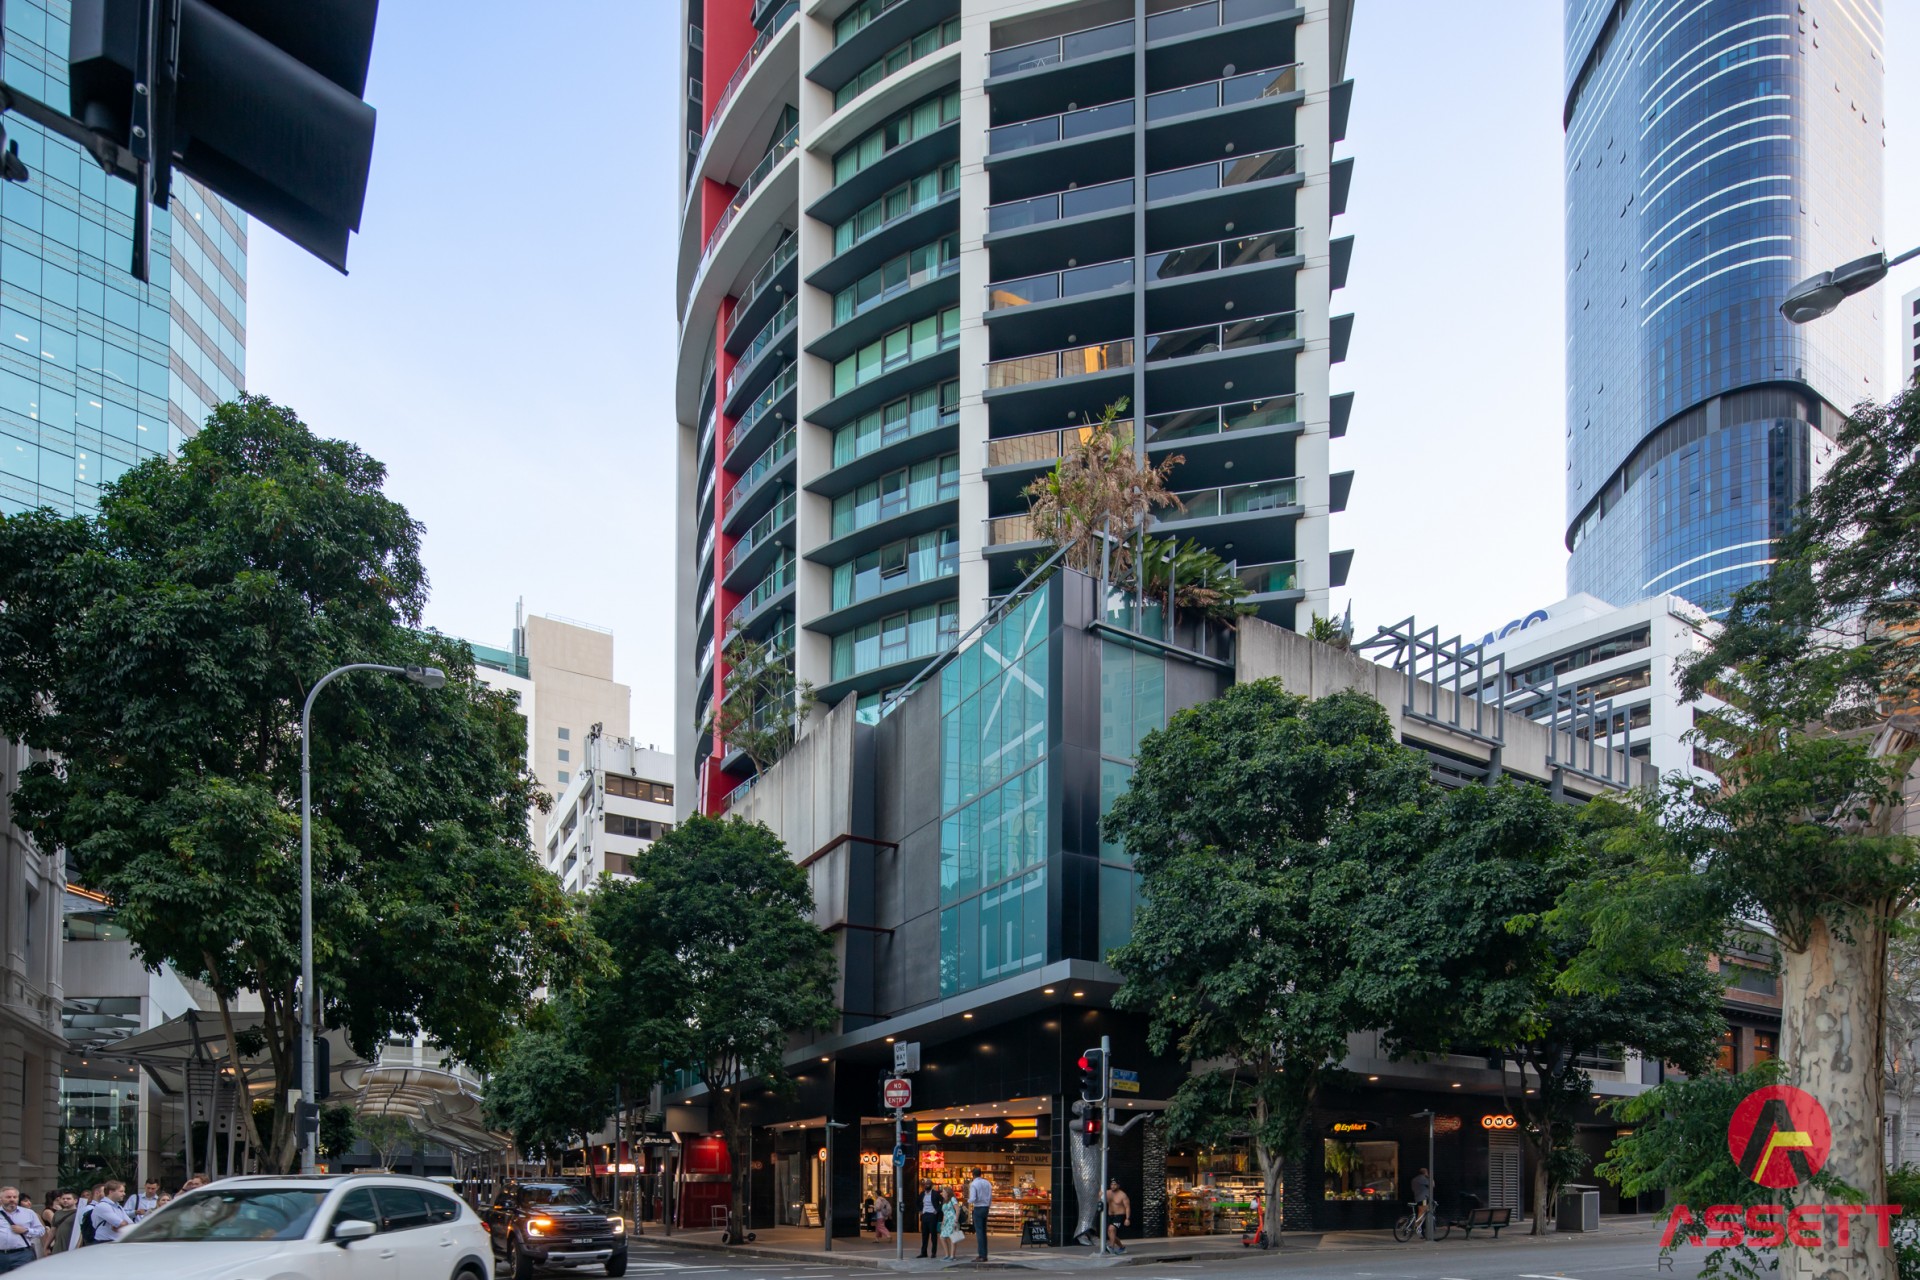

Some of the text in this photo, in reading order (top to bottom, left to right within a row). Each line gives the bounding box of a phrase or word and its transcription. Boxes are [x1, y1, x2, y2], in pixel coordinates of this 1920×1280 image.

[895, 1044, 905, 1053] ONE
[955, 1123, 999, 1138] EzyMart
[1341, 1123, 1367, 1132] EzyMart
